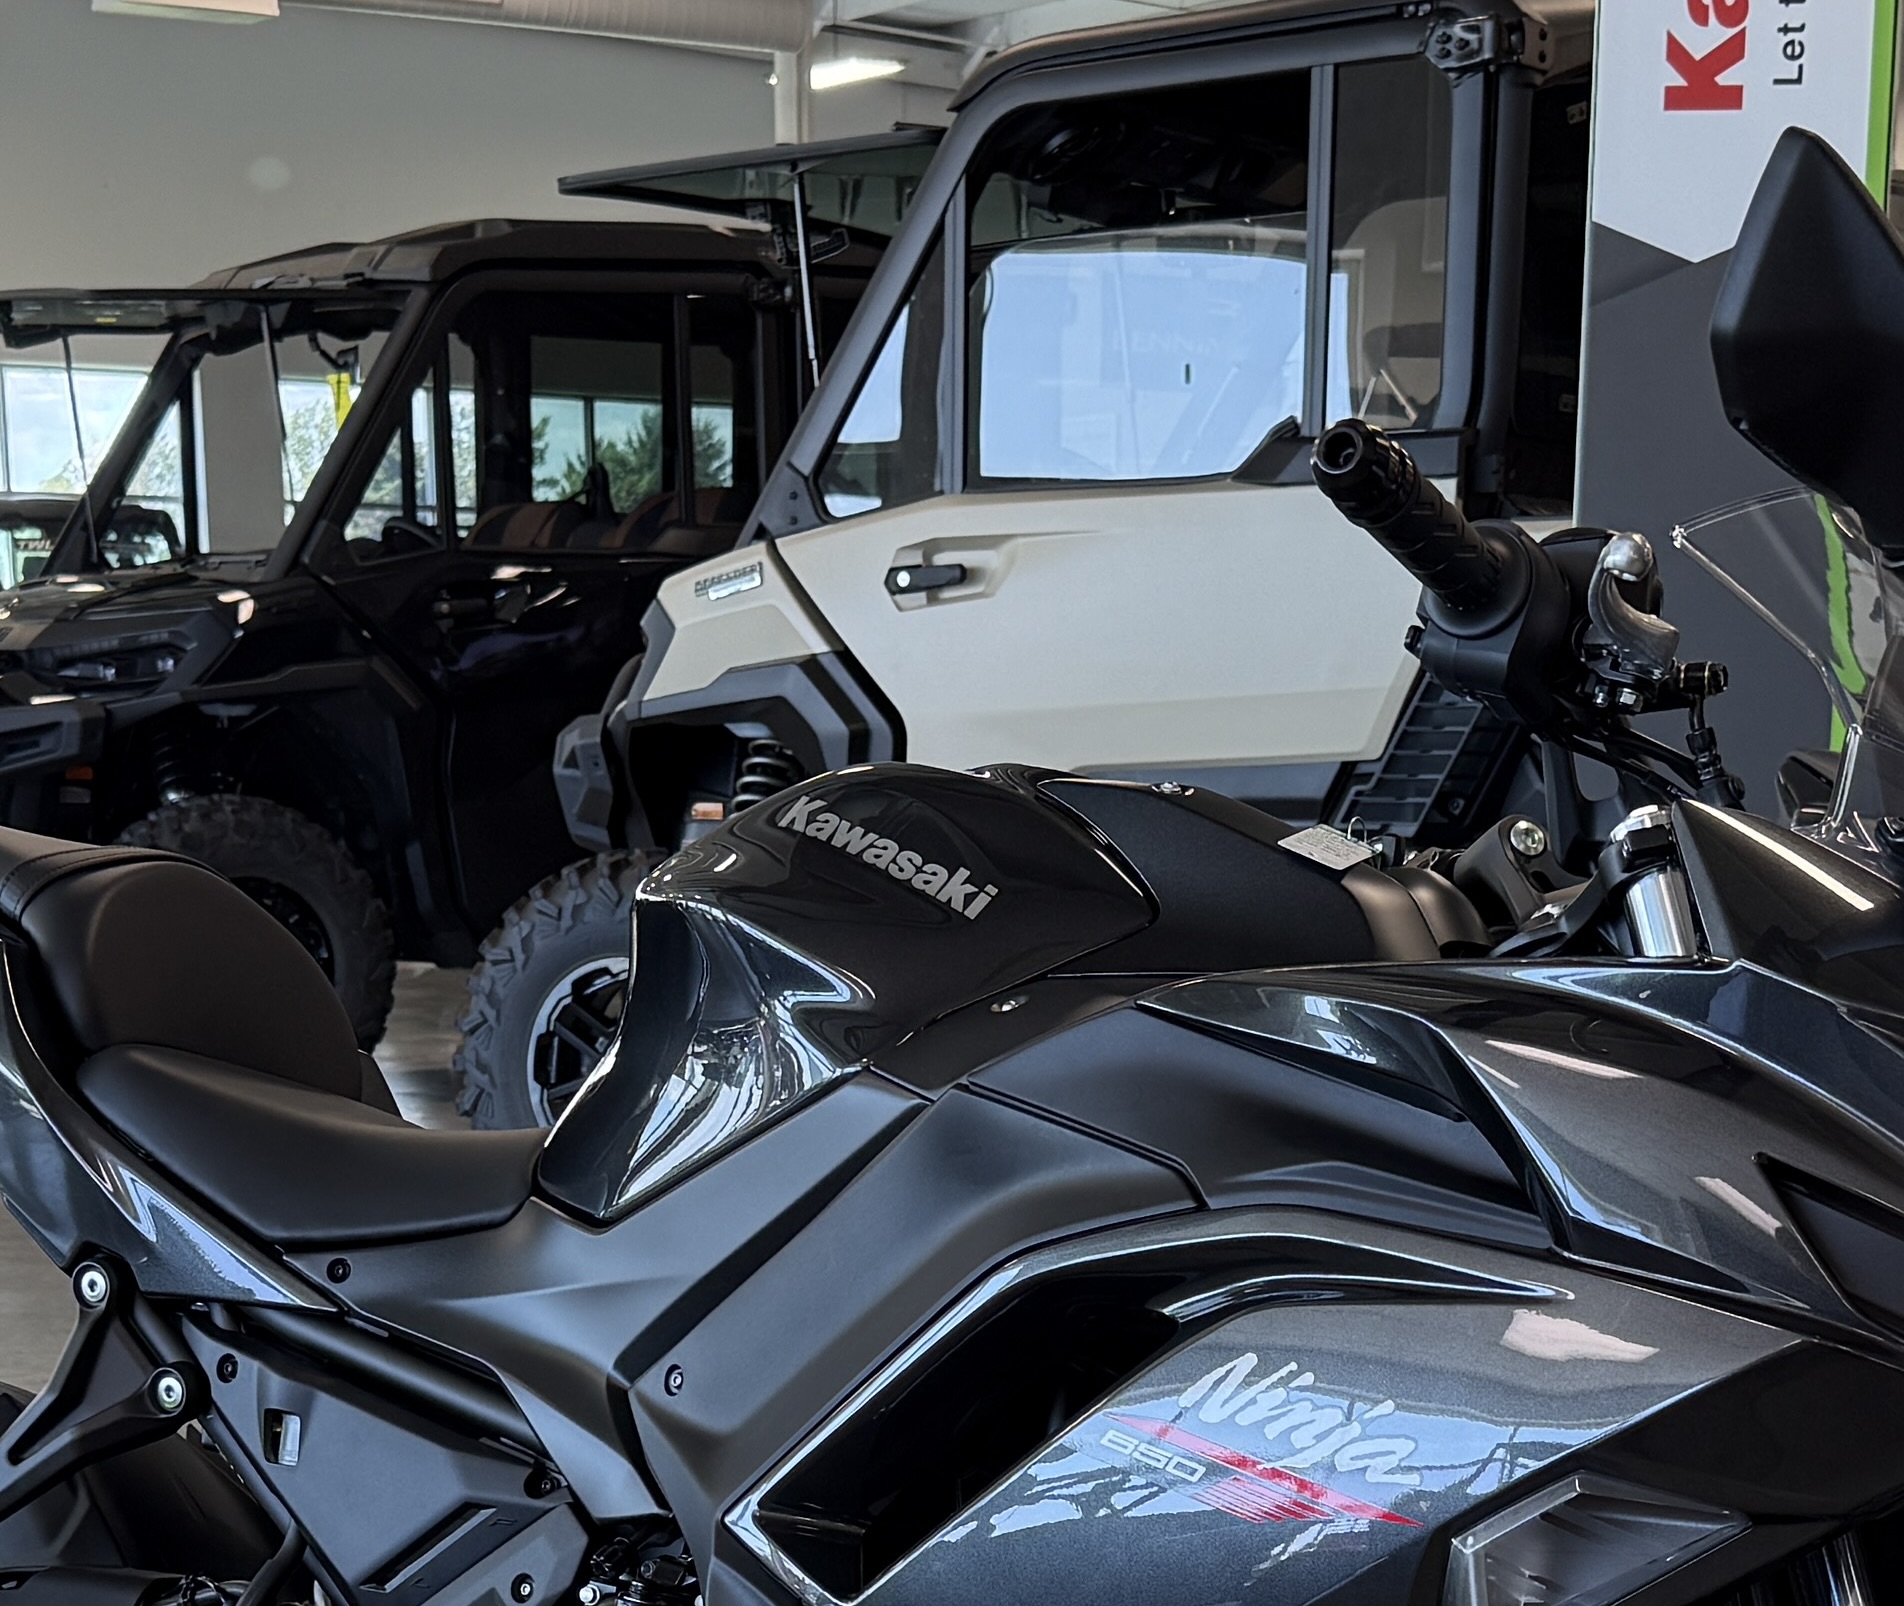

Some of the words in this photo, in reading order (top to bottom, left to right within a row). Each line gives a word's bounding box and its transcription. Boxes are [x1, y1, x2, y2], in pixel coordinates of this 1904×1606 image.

[1772, 22, 1806, 86] Let
[777, 795, 999, 920] Kawasaki
[1100, 1429, 1207, 1482] 650
[1177, 1352, 1425, 1486] Ninja
